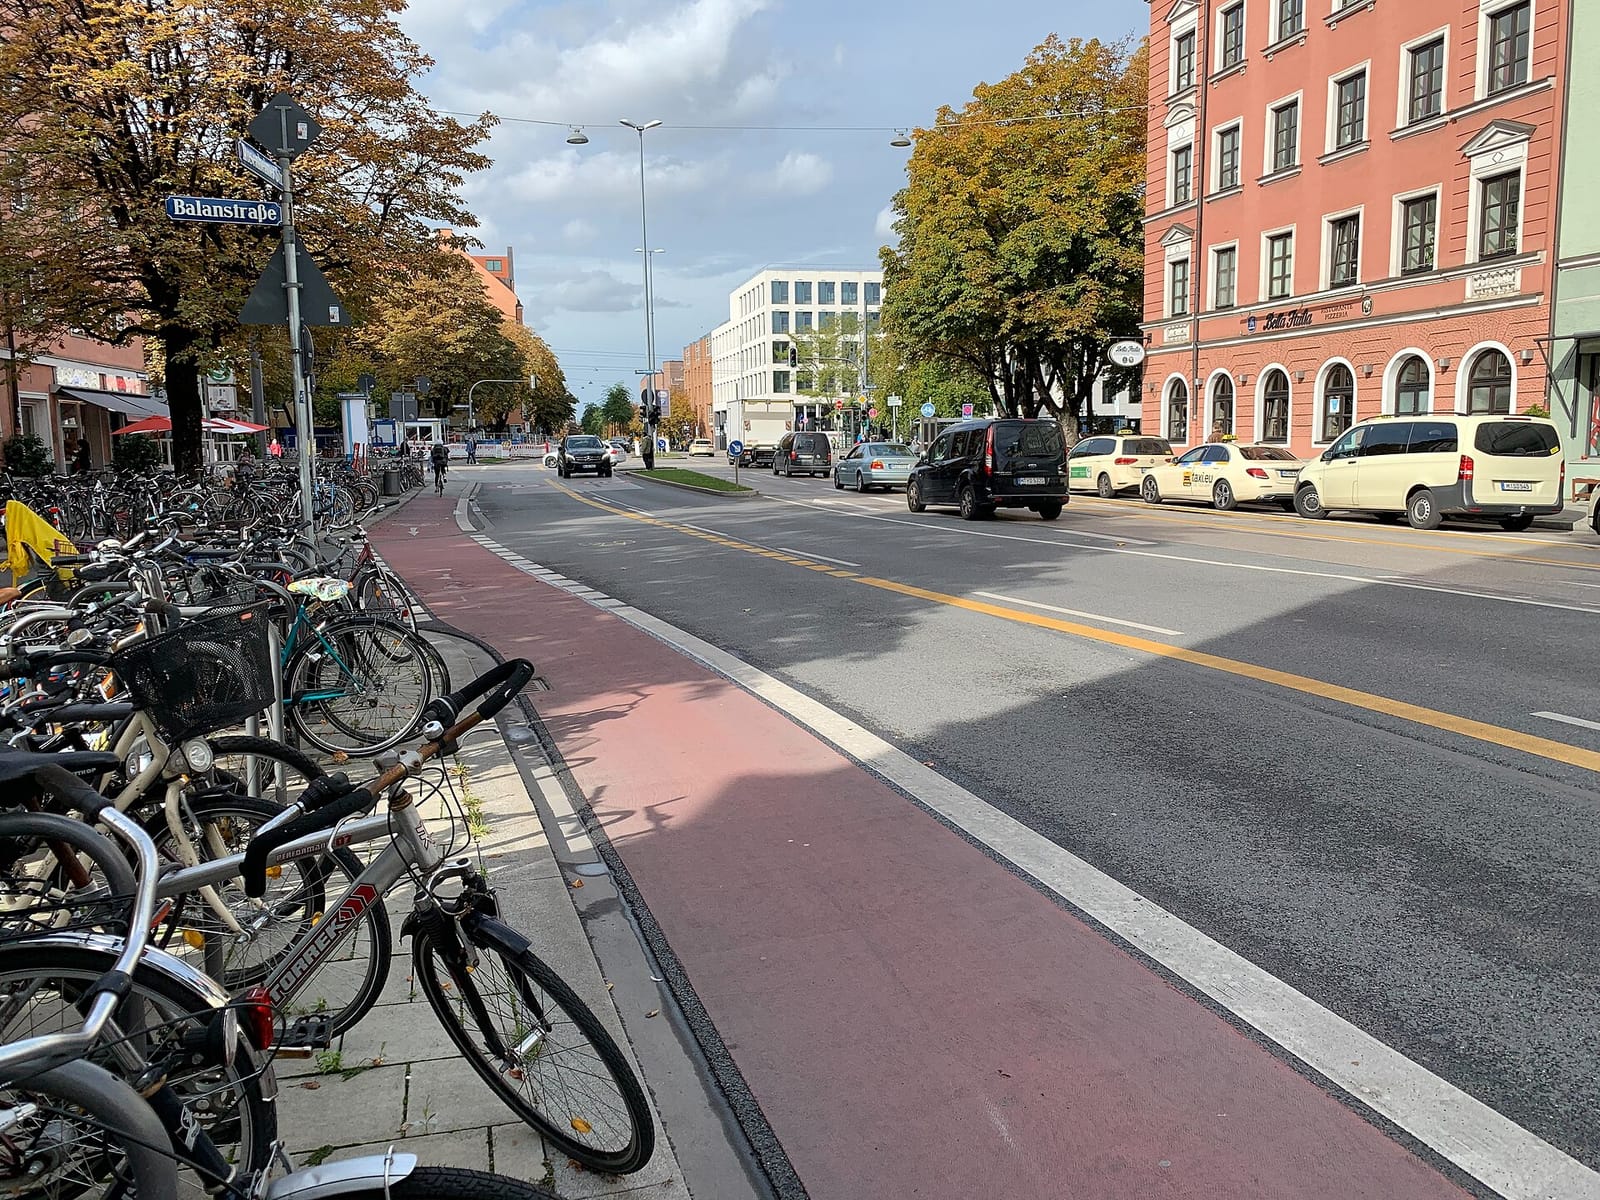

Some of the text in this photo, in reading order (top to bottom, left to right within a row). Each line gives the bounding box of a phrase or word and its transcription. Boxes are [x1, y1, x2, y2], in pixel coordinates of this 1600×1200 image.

[173, 199, 277, 223] Balanstraße
[1263, 308, 1313, 331] Bella Italia
[1324, 311, 1349, 320] PIZZERIA
[1191, 471, 1214, 484] taxi.eu
